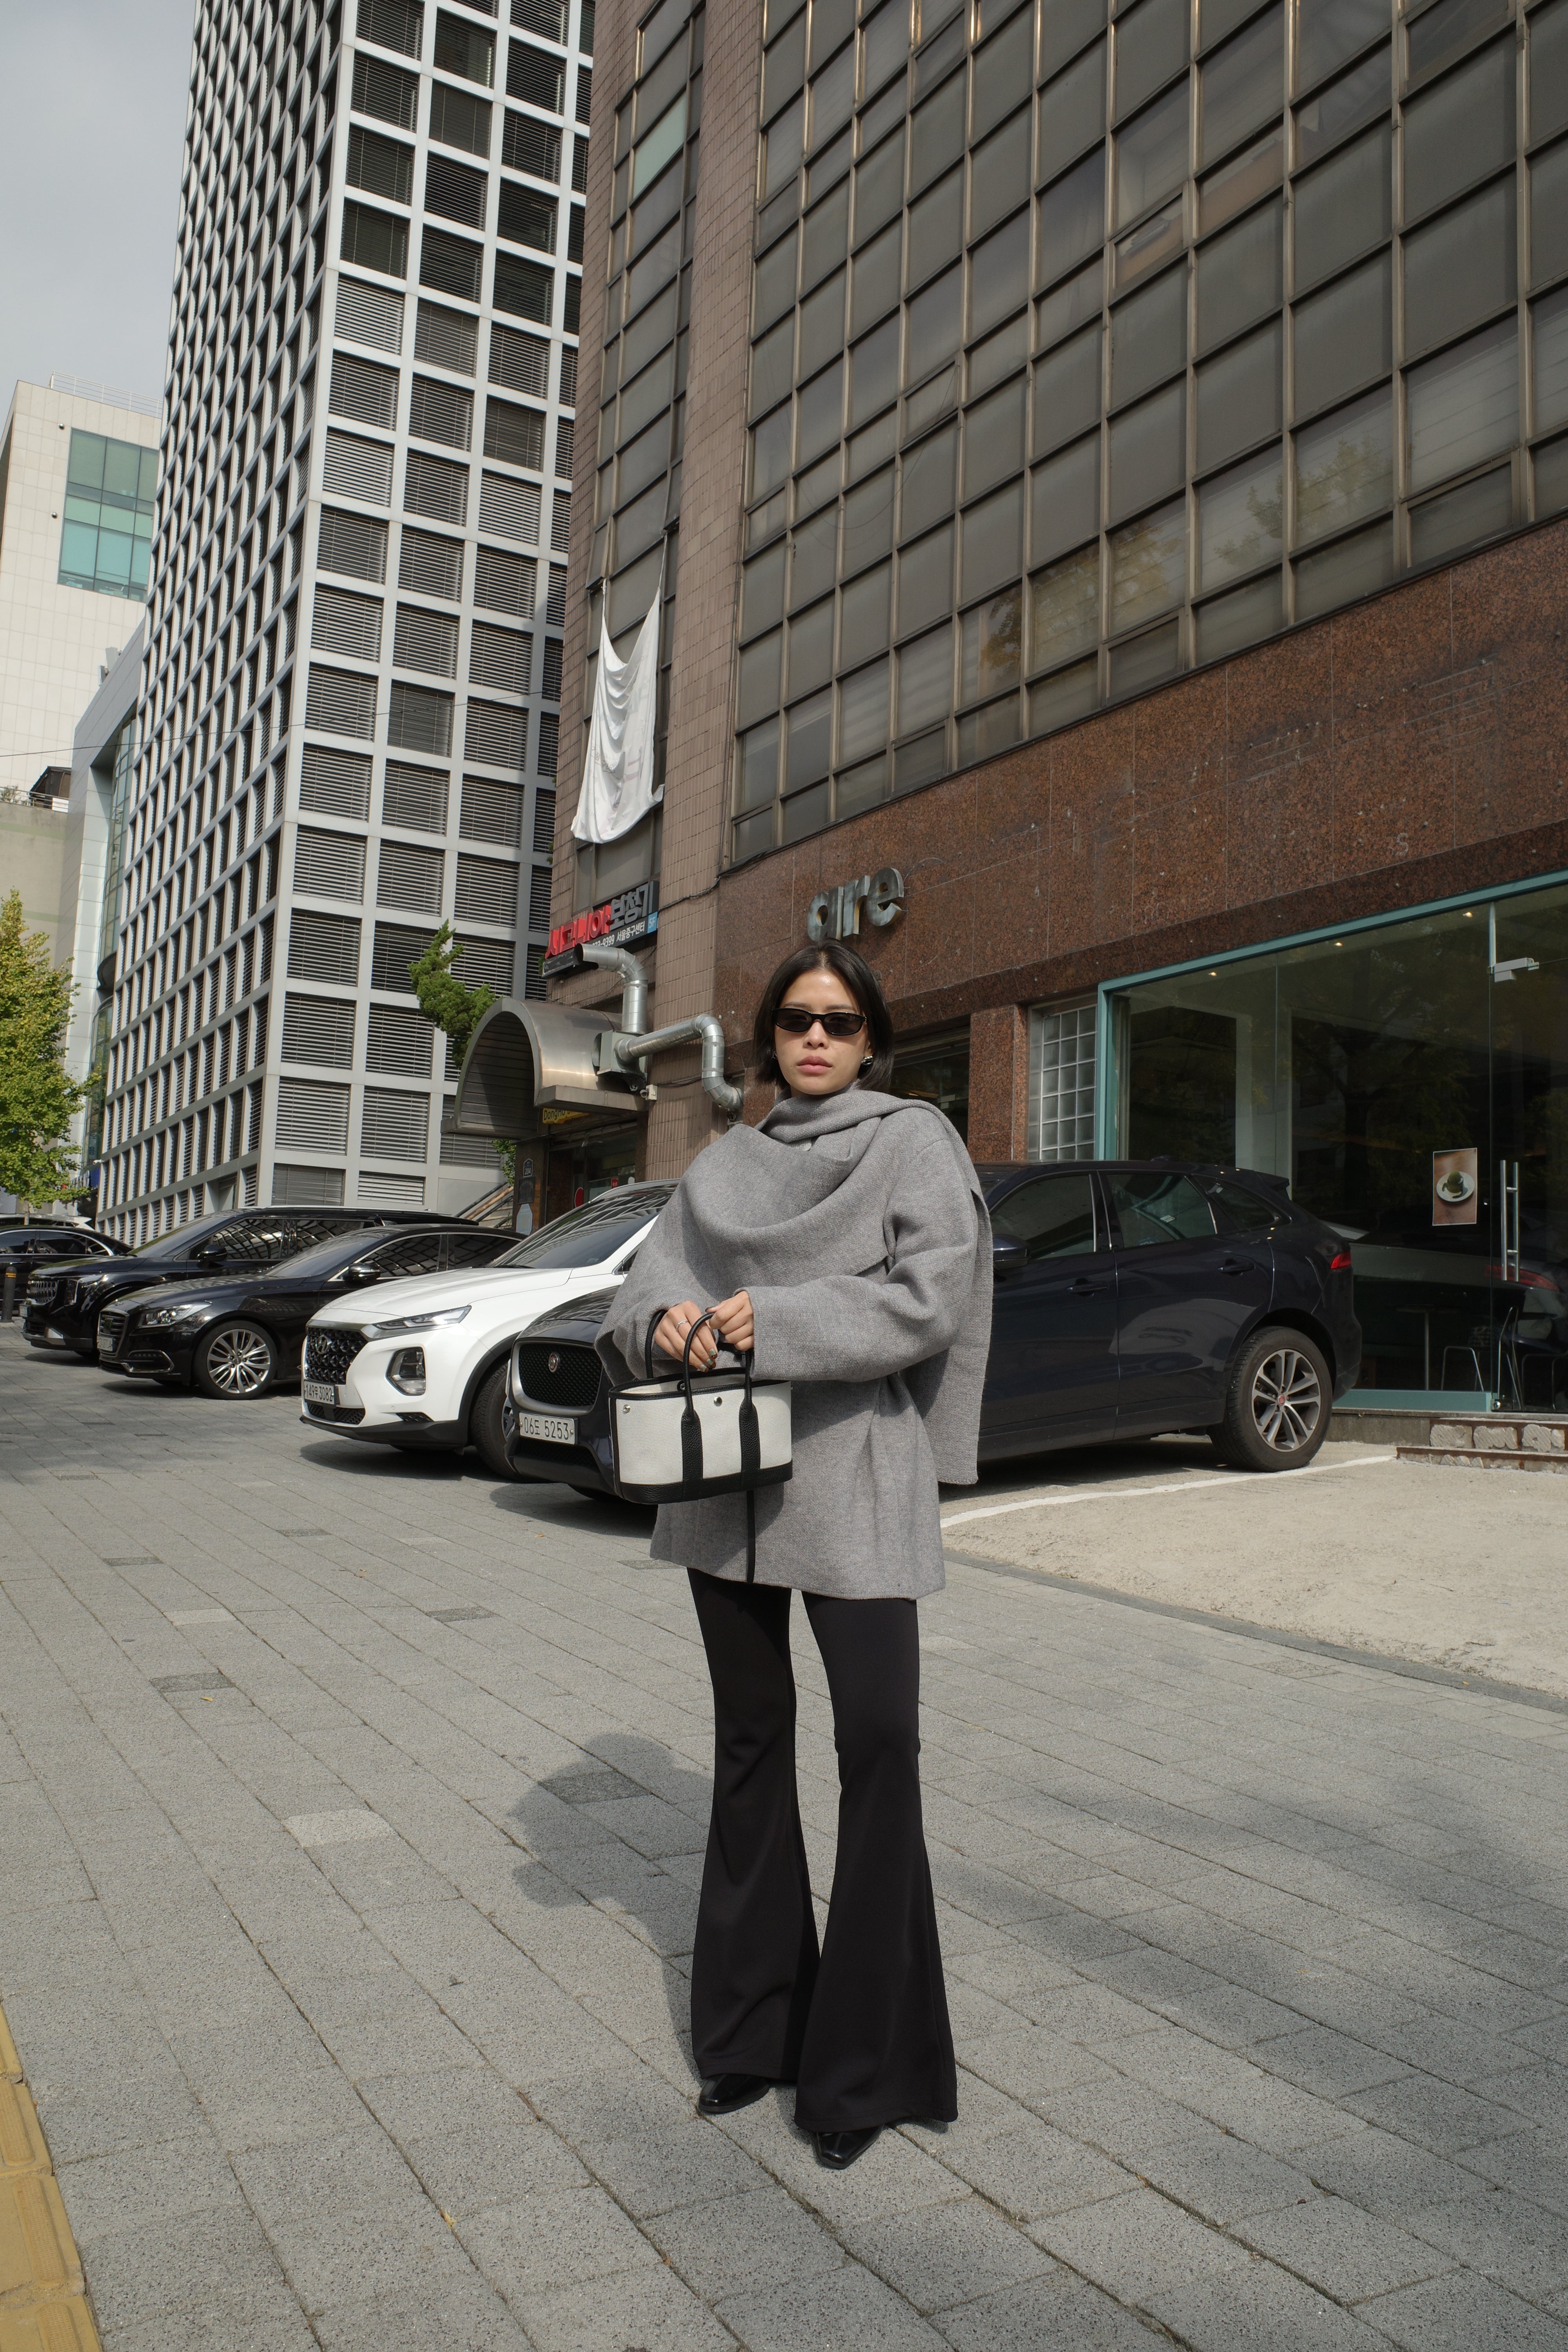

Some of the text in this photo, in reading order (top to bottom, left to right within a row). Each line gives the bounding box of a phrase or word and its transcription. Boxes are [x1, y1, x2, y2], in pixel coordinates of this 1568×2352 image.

[807, 867, 904, 941] are
[592, 935, 615, 947] -9399
[649, 916, 656, 928] 5F
[319, 1386, 333, 1402] 3082
[524, 1416, 569, 1440] 06도 5253
